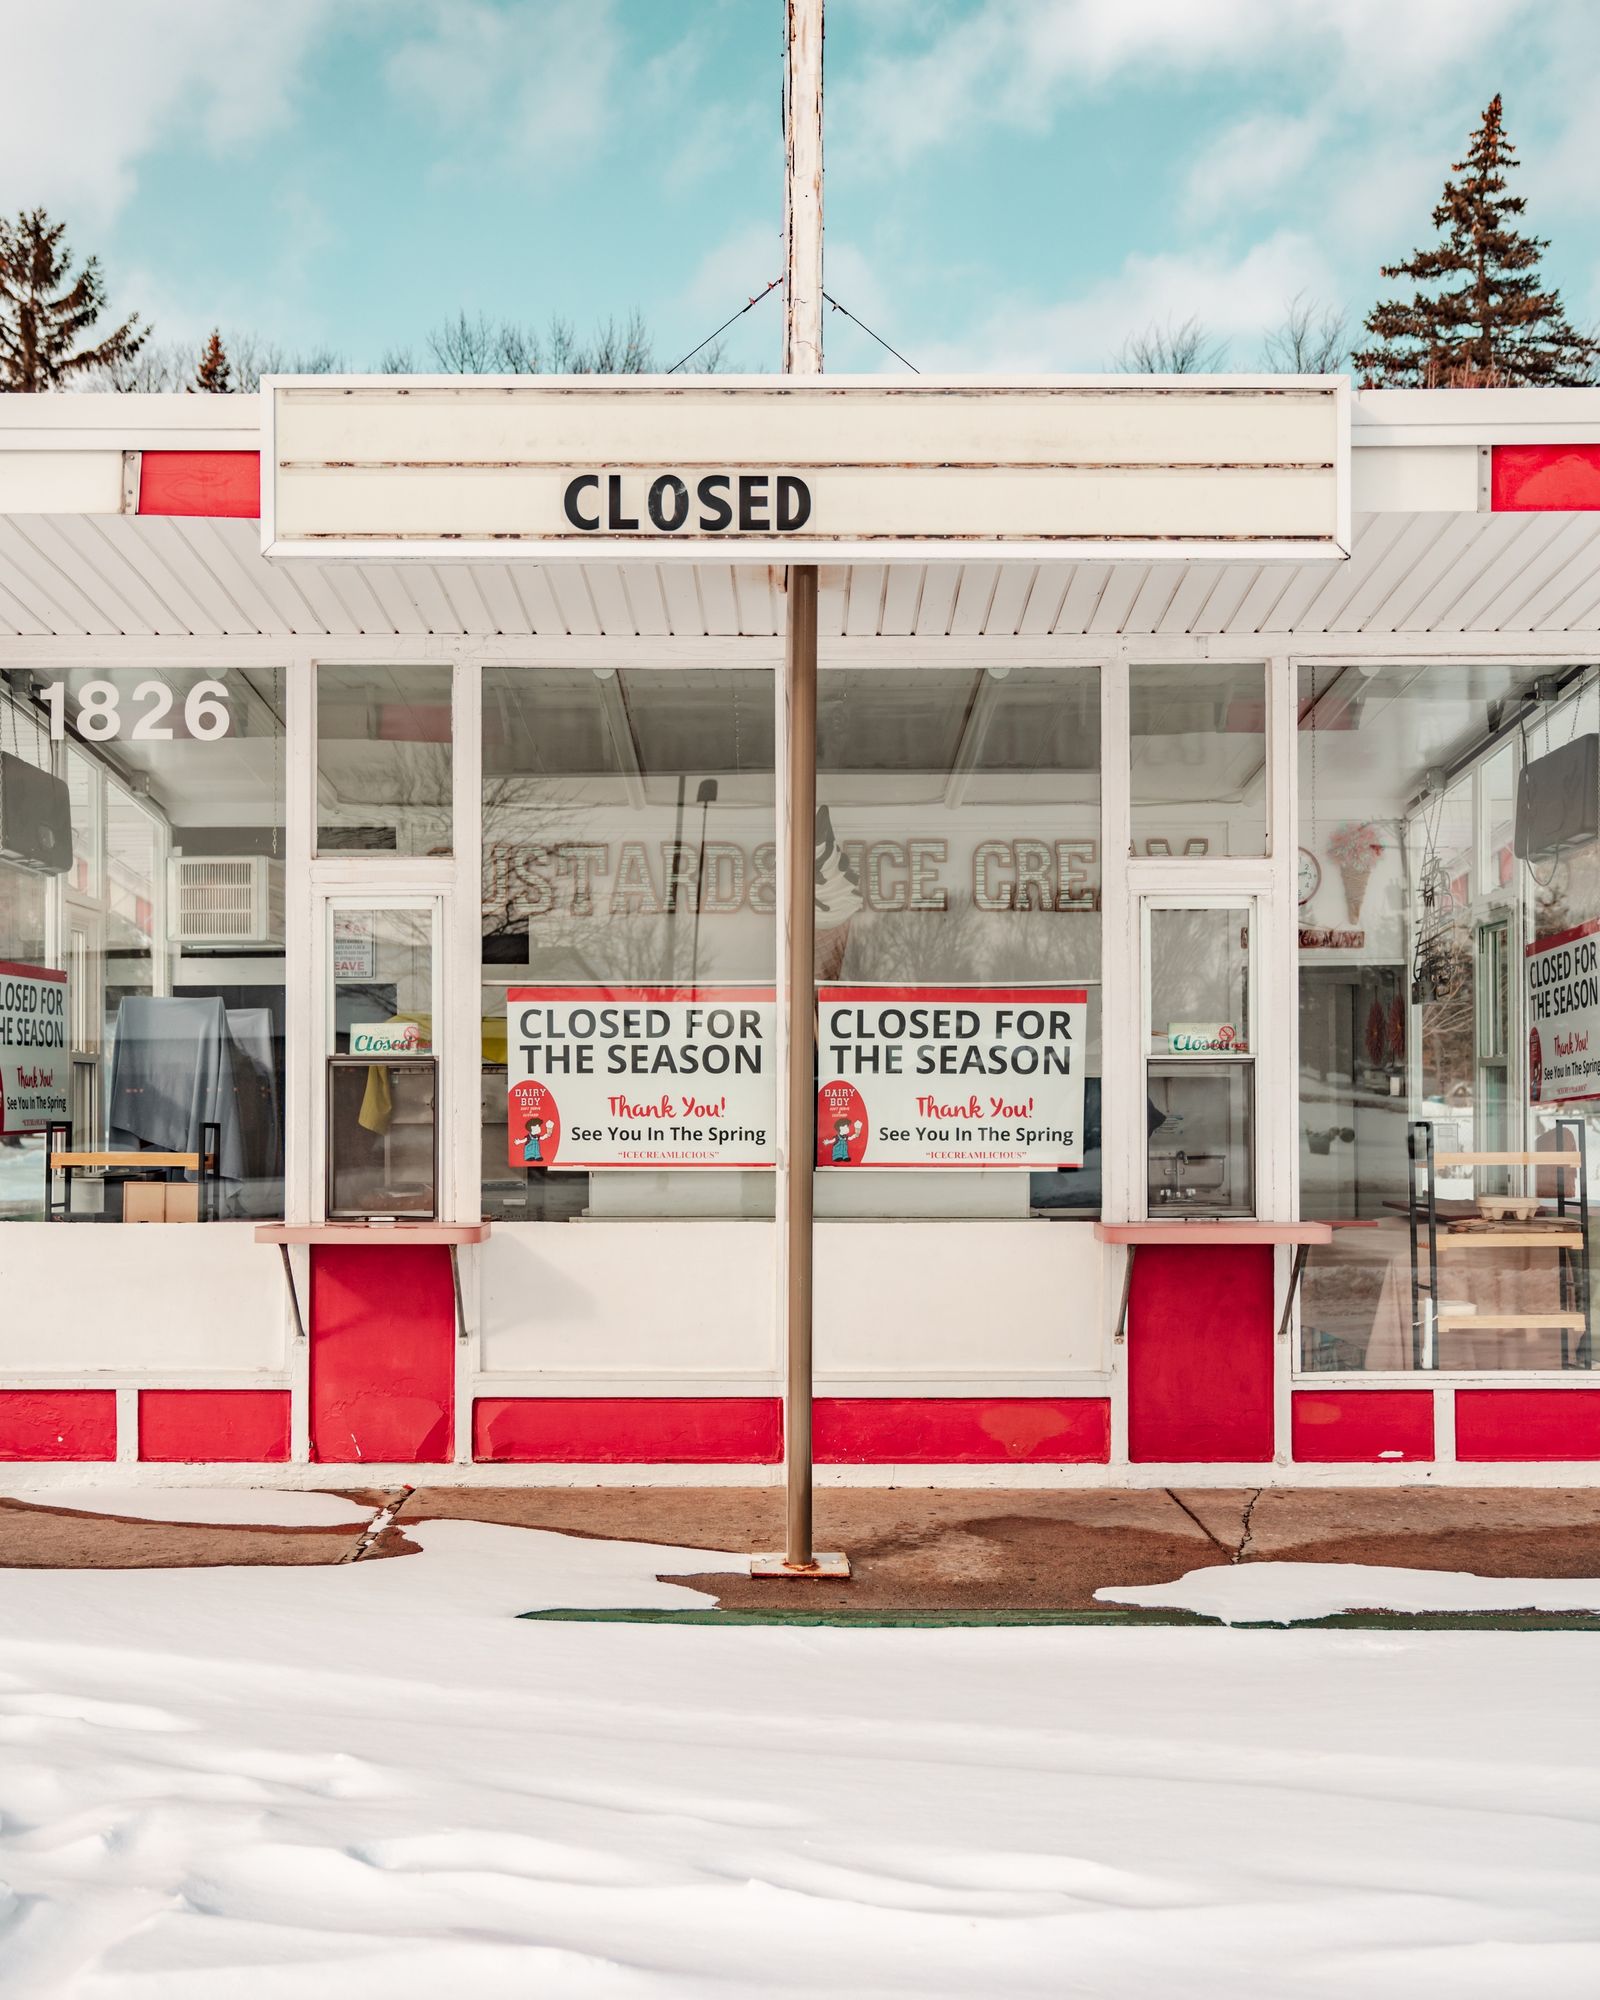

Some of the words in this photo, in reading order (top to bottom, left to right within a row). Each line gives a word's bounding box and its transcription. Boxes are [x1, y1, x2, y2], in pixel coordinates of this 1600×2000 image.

[564, 474, 811, 531] CLOSED
[40, 680, 230, 741] 1826
[1529, 950, 1572, 990] CLOSED
[1575, 941, 1598, 977] FOR
[40, 987, 64, 1016] FOR
[1530, 990, 1551, 1022] THE
[1553, 976, 1599, 1016] SEASON
[16, 1017, 64, 1048] SEASON
[519, 1008, 671, 1039] CLOSED
[686, 1008, 763, 1039] FOR
[830, 1008, 981, 1039] CLOSED
[995, 1008, 1073, 1039] FOR
[354, 1033, 412, 1052] Closed
[1173, 1033, 1230, 1051] Closed
[1554, 1031, 1574, 1058] Thank
[1574, 1029, 1589, 1053] You!
[519, 1044, 594, 1075] THE
[607, 1044, 762, 1075] SEASON
[829, 1044, 903, 1076] THE
[916, 1044, 1071, 1076] SEASON
[1543, 1066, 1553, 1081] See
[1553, 1065, 1564, 1080] You
[1564, 1063, 1571, 1078] In
[1571, 1061, 1582, 1077] The
[1582, 1057, 1600, 1079] Spring
[17, 1066, 38, 1090] Thank
[39, 1067, 53, 1088] You!
[6, 1096, 17, 1111] See
[17, 1096, 29, 1110] You
[29, 1095, 36, 1110] In
[36, 1095, 47, 1110] The
[47, 1095, 67, 1113] Spring
[515, 1088, 547, 1097] DAIRY
[520, 1097, 541, 1106] BOY
[824, 1088, 856, 1098] DAIRY
[830, 1097, 850, 1106] BOY
[607, 1094, 676, 1120] Thank
[681, 1094, 726, 1120] You!
[916, 1094, 984, 1120] Thank
[990, 1094, 1034, 1120] You!
[571, 1126, 603, 1141] See
[607, 1126, 642, 1141] You
[647, 1126, 665, 1141] In
[669, 1126, 703, 1141] The
[708, 1126, 767, 1146] Spring
[879, 1126, 911, 1141] See
[915, 1126, 949, 1141] You
[955, 1126, 972, 1141] In
[977, 1126, 1011, 1141] The
[1015, 1126, 1074, 1147] Spring
